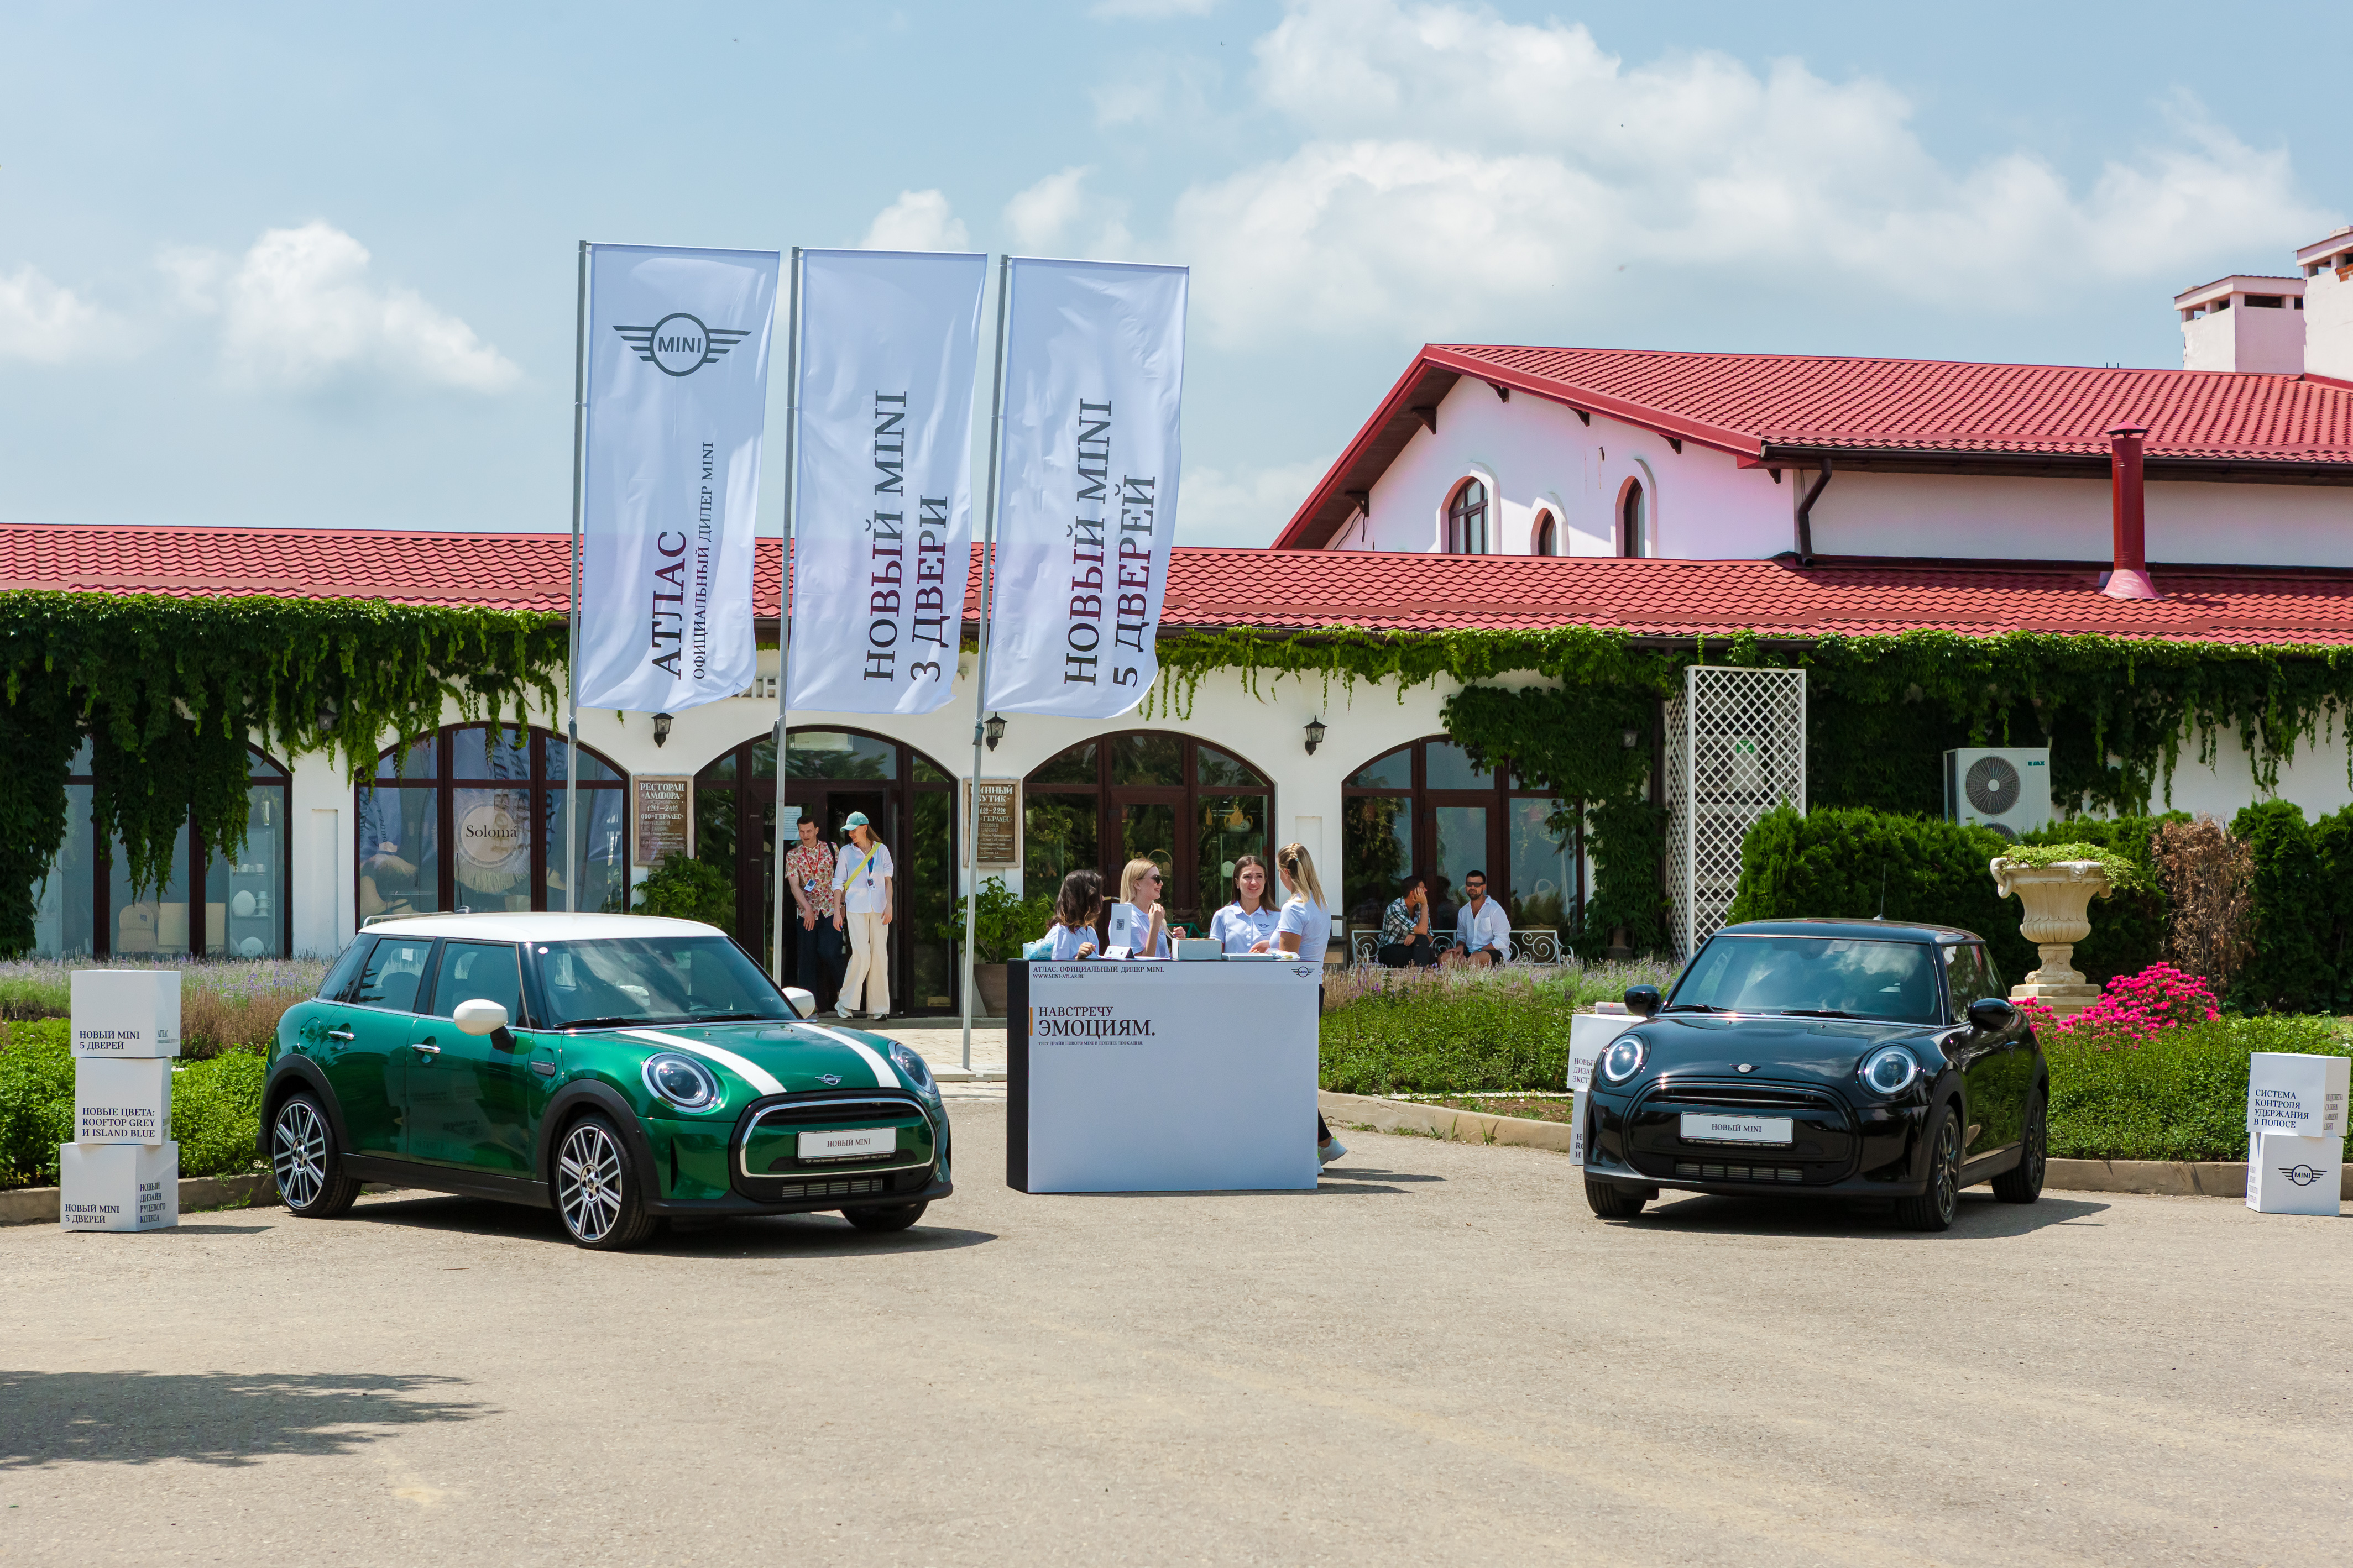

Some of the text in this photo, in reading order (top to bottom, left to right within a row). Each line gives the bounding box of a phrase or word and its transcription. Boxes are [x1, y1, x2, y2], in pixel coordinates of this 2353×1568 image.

[658, 337, 702, 353] MINI
[864, 390, 907, 682] НОВЫЙ MINI
[1064, 398, 1111, 686] НОВЫЙ MINI
[693, 442, 713, 679] ОФИЦИАЛЬНЫЙ ДИЛЕР MINI
[1113, 475, 1155, 688] 5 ДВЕРЕЙ
[910, 495, 950, 683] 3 ДВЕРИ
[652, 531, 686, 680] АТЛАС
[640, 783, 684, 791] РЕСТОРАН
[466, 825, 517, 838] Solomá
[1038, 1006, 1113, 1017] НАВСТРЕЧУ
[79, 1030, 140, 1039] НОВЫЙ MINI
[1038, 1020, 1155, 1039] ЭМОЦИЯМ.
[87, 1041, 124, 1050] ДВЕРЕЙ
[1573, 1066, 1593, 1075] ДИЗА
[1572, 1076, 1589, 1084] ЭКСТ
[2255, 1089, 2296, 1099] СИСТЕМА
[2255, 1099, 2300, 1109] КОНТРОЛЯ
[82, 1107, 155, 1117] НОВЫЕ ЦВЕТА:
[2254, 1108, 2309, 1120] УДЕРЖАНИЯ
[82, 1118, 127, 1126] ROOFTOP
[1712, 1123, 1741, 1131] НОВЫЙ
[2261, 1119, 2296, 1128] ПОЛОСЕ
[130, 1129, 155, 1137] BLUE
[827, 1138, 854, 1147] НОВЫЙ
[140, 1181, 160, 1192] НОВЫЙ
[139, 1192, 162, 1203] ДИЗАЙН
[65, 1204, 120, 1213] НОВЫЙ MINI
[140, 1202, 166, 1213] РУЛЕВОГО
[72, 1215, 106, 1224] ДВЕРЕЙ
[140, 1214, 160, 1223] КОЛЕСА
